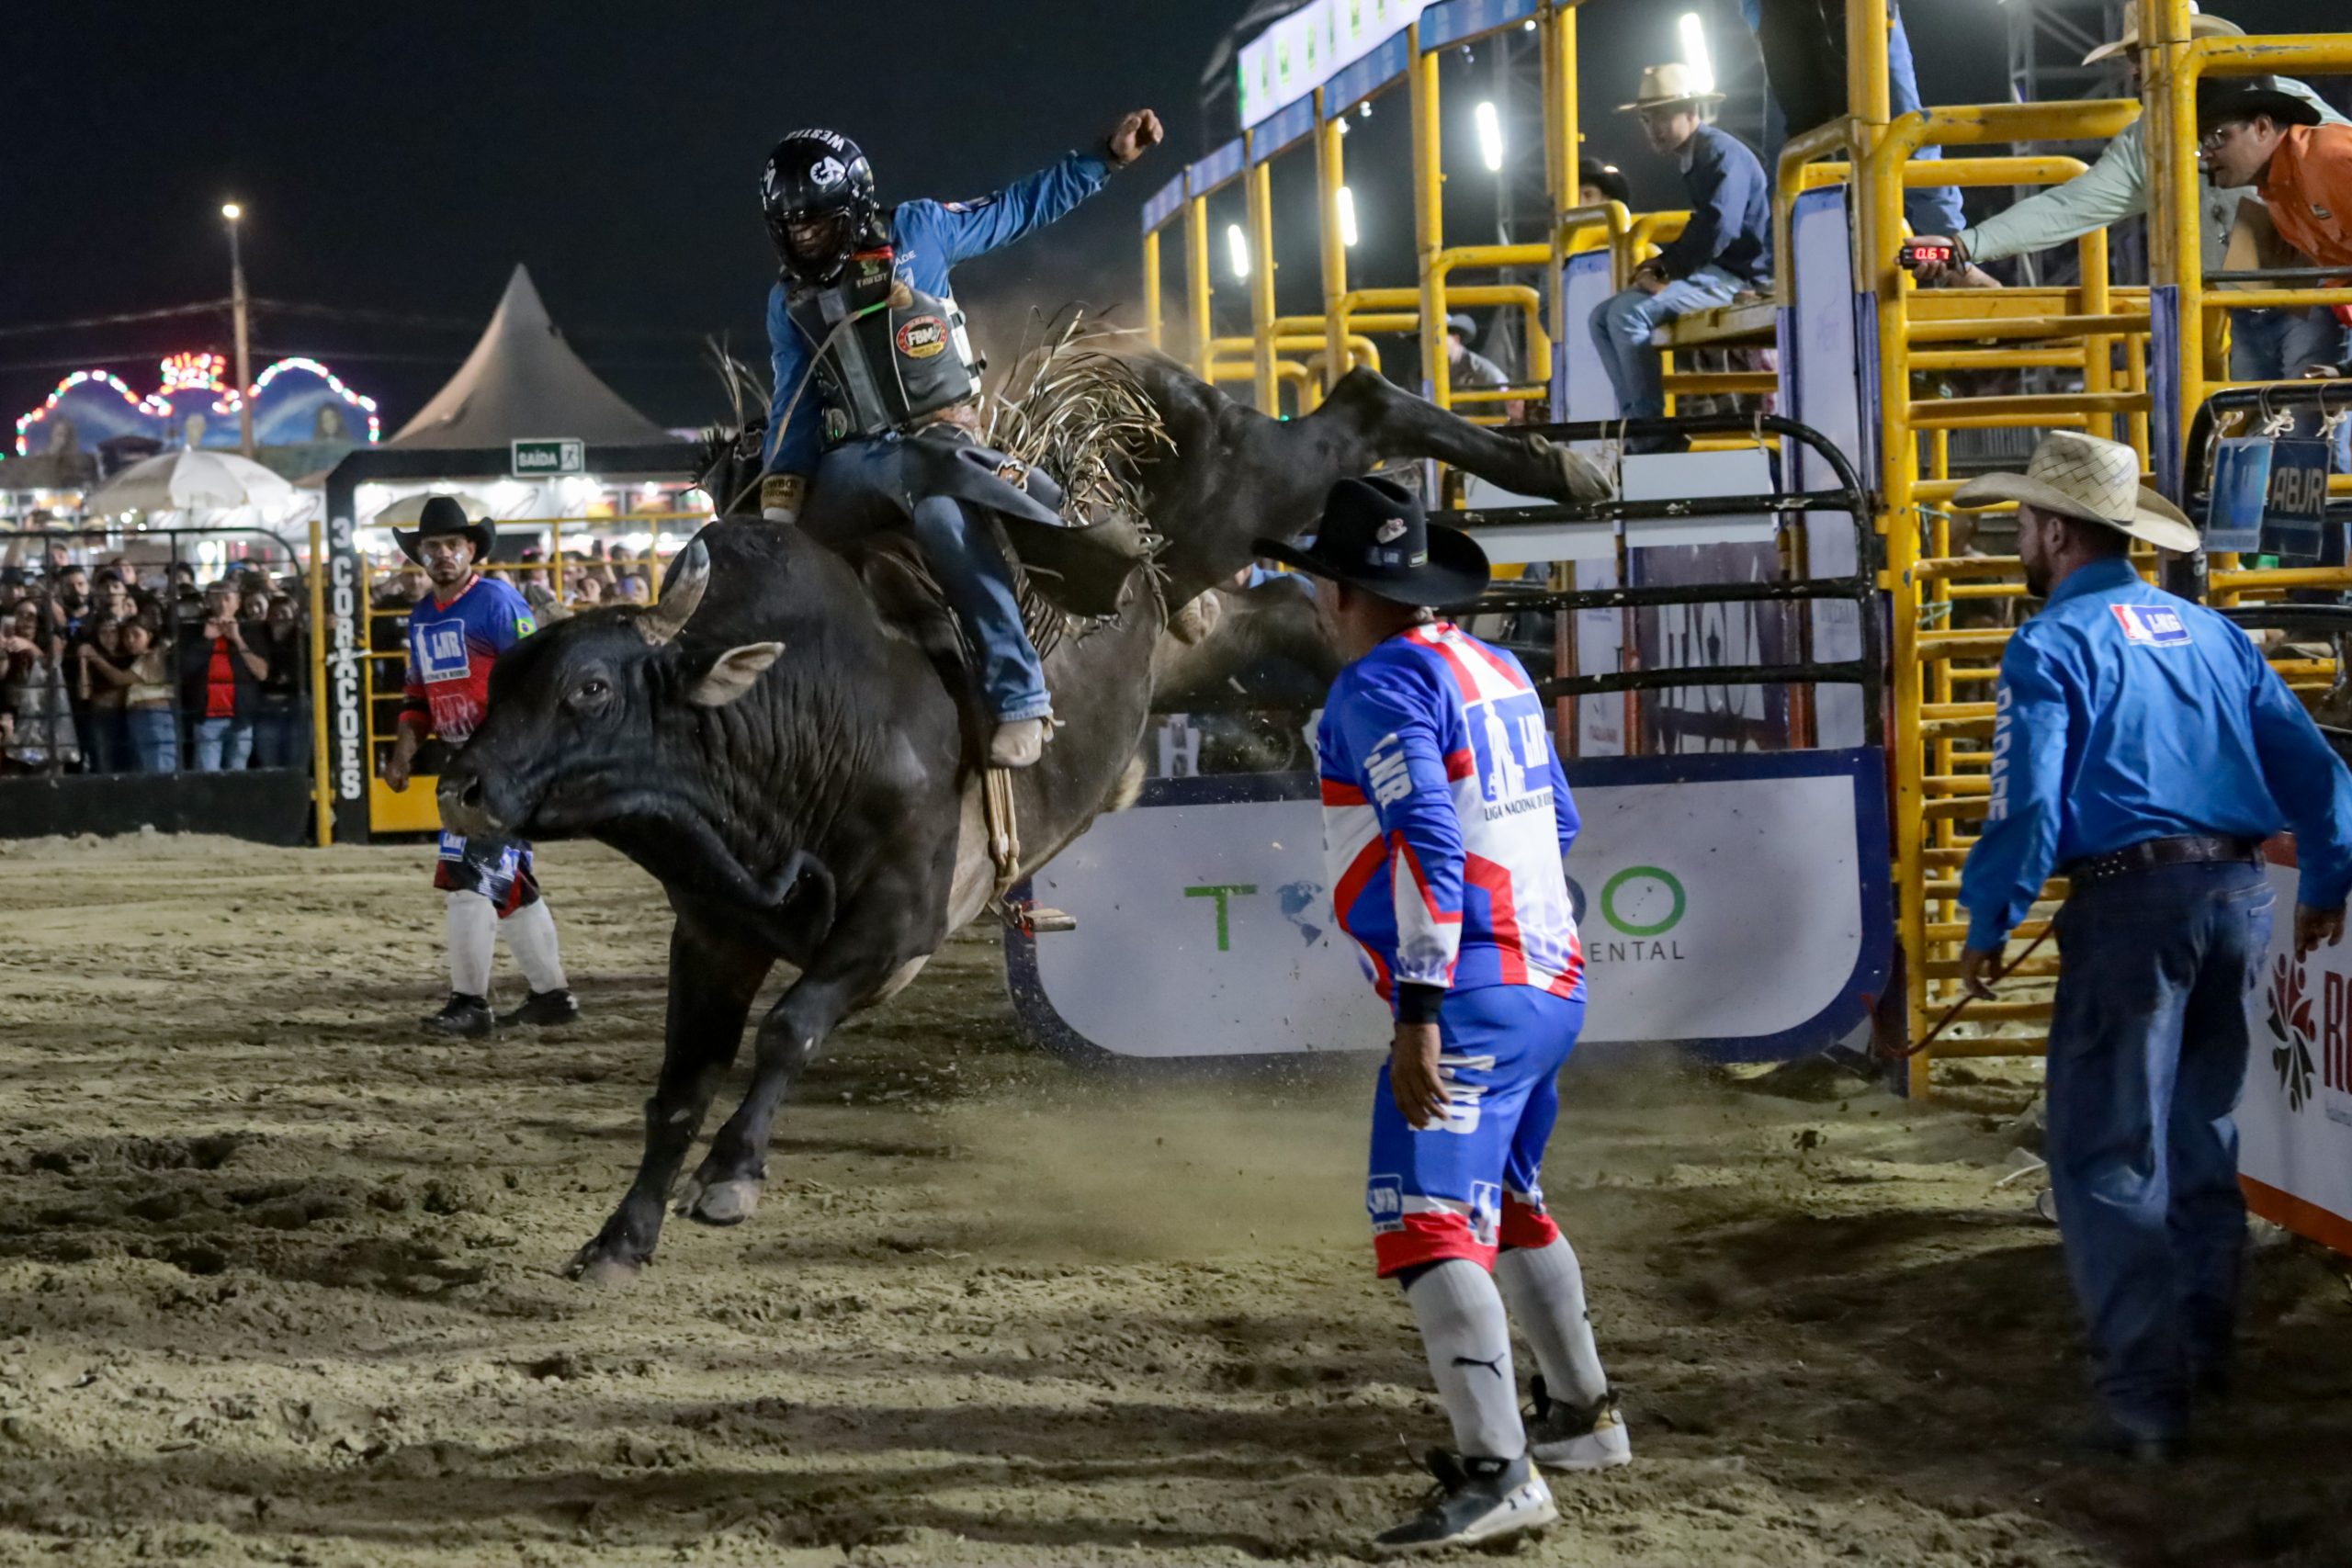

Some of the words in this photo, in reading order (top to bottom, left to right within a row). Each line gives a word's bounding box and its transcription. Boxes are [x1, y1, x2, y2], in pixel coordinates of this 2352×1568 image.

[895, 250, 917, 266] ADE
[907, 327, 933, 346] FBM
[332, 517, 352, 549] 3
[1589, 940, 1686, 963] ENTAL
